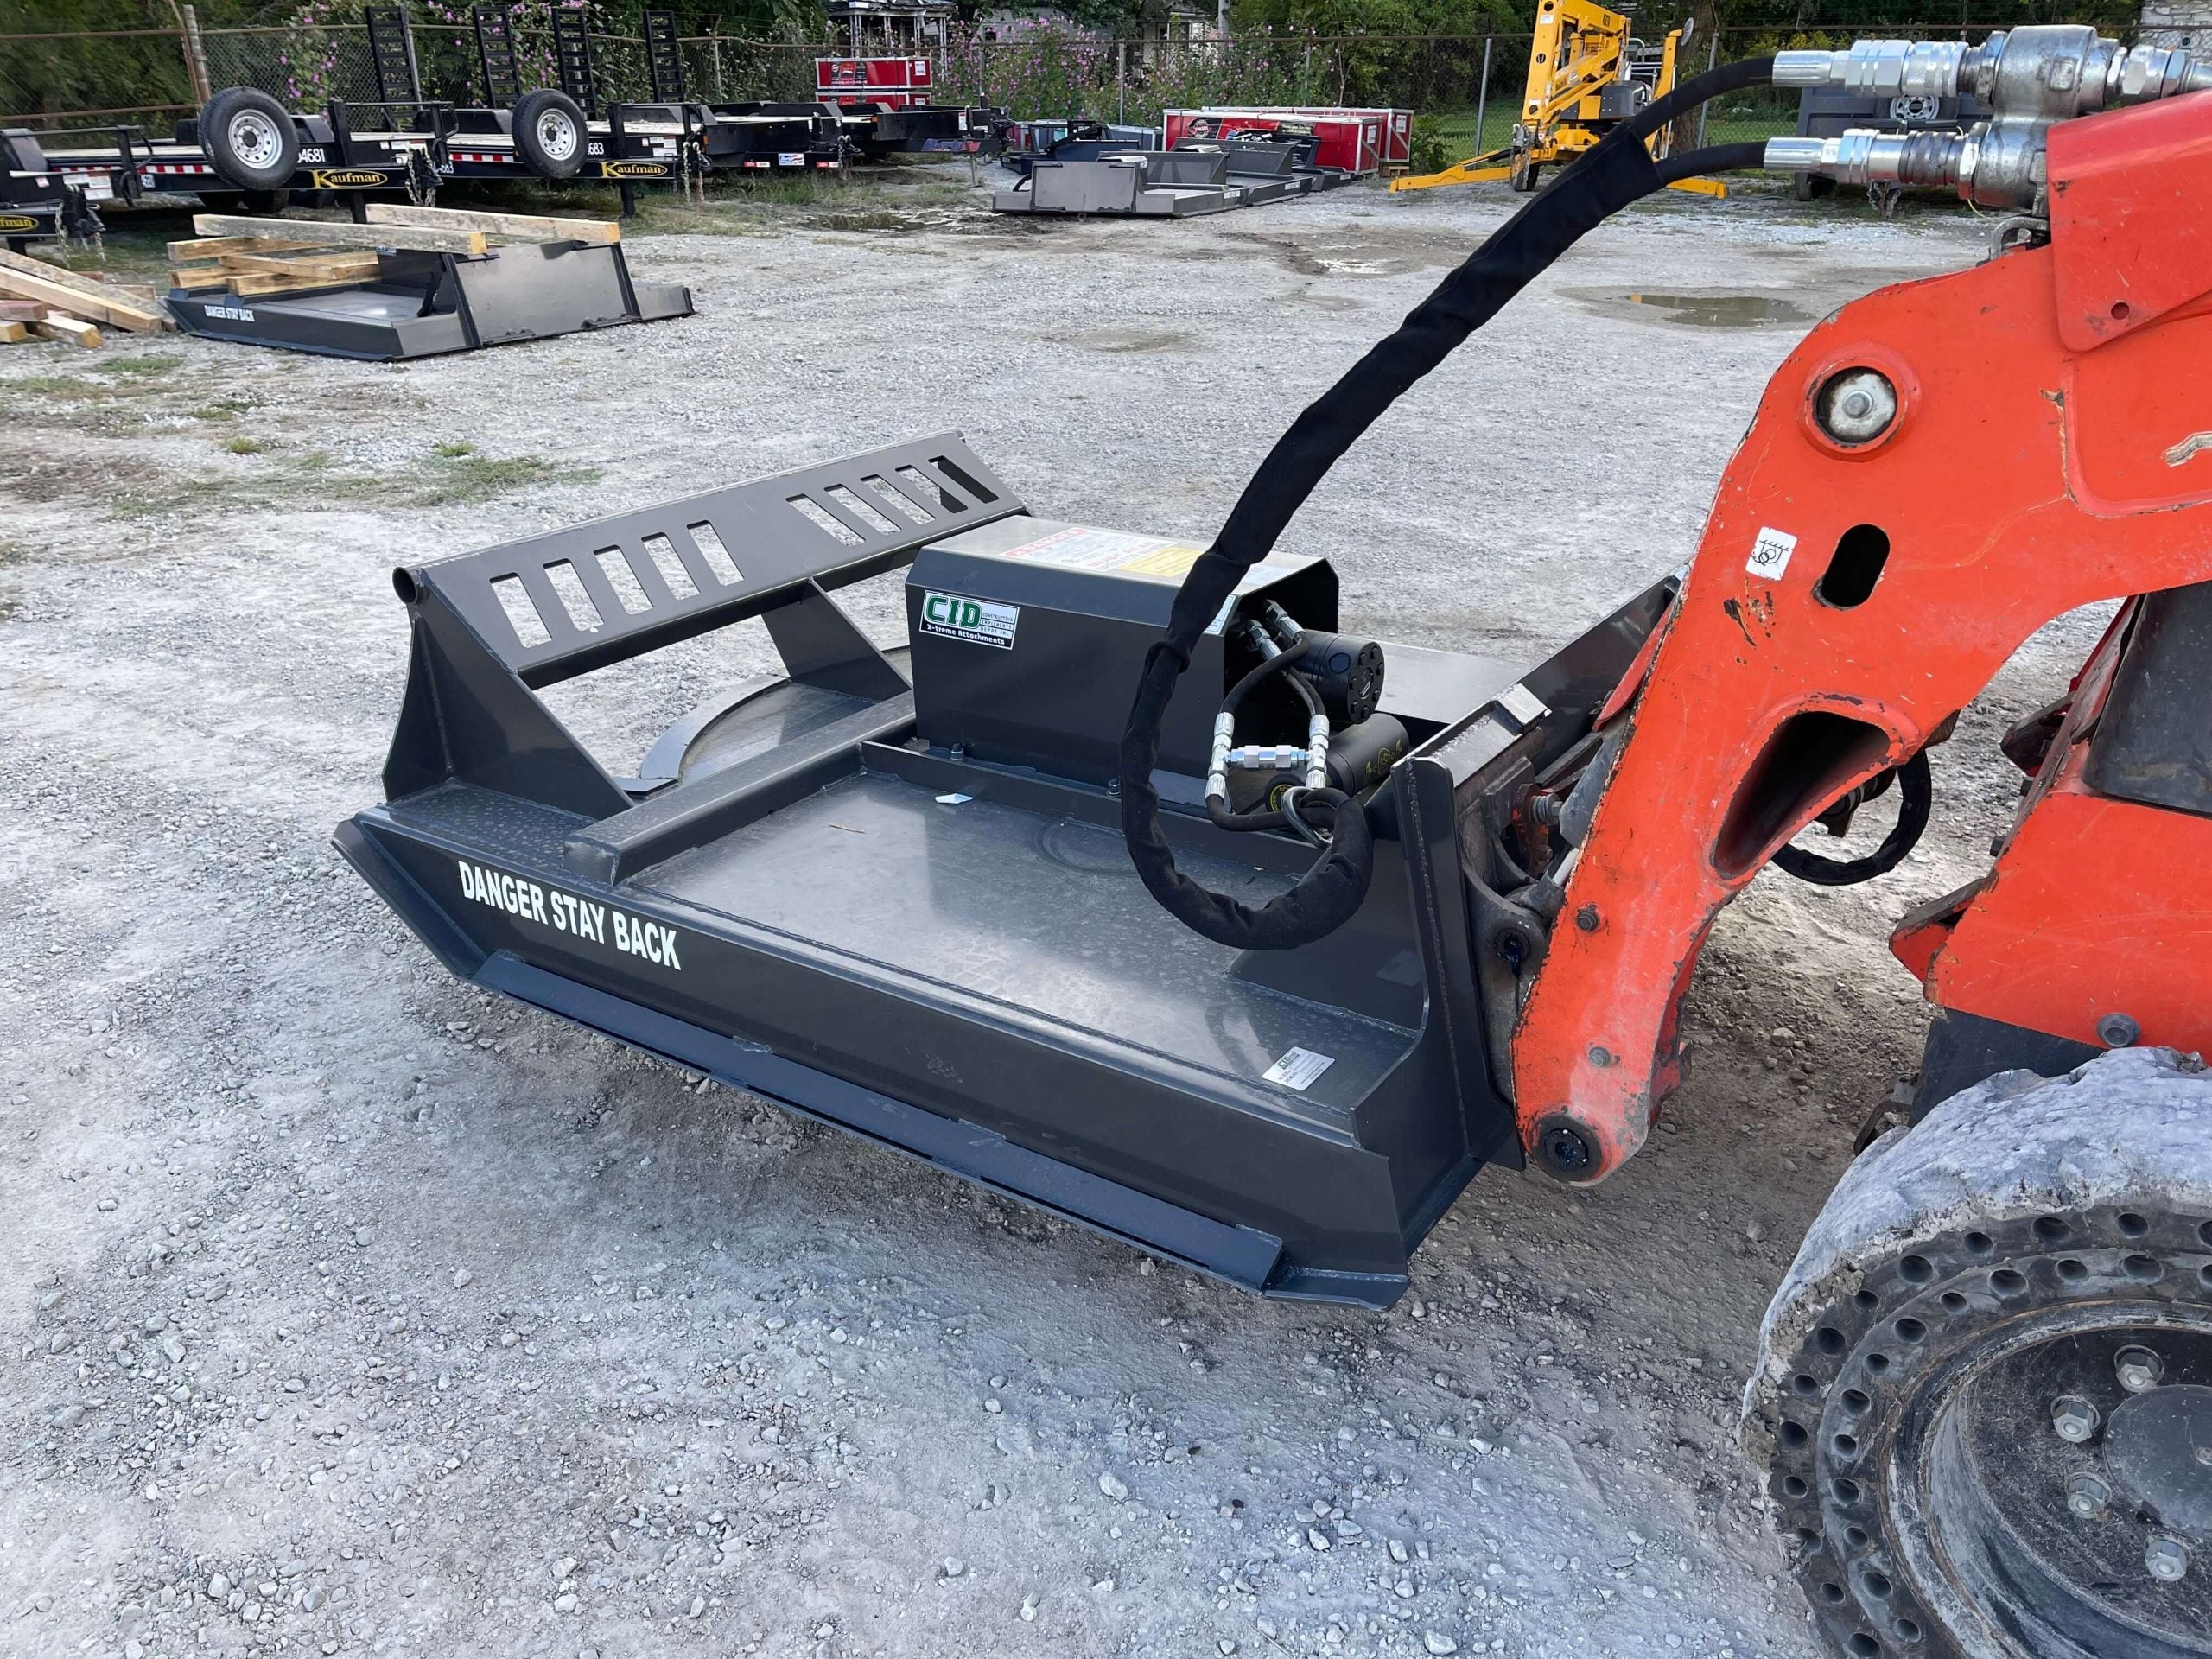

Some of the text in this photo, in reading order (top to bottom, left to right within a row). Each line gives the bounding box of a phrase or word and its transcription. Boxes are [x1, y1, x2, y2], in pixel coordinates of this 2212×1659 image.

[311, 169, 381, 189] Kaufman
[600, 162, 662, 179] Kaufman
[927, 596, 982, 629] CID
[926, 623, 1005, 645] X-treme Attachments
[458, 861, 682, 970] DANGER STAY BACK
